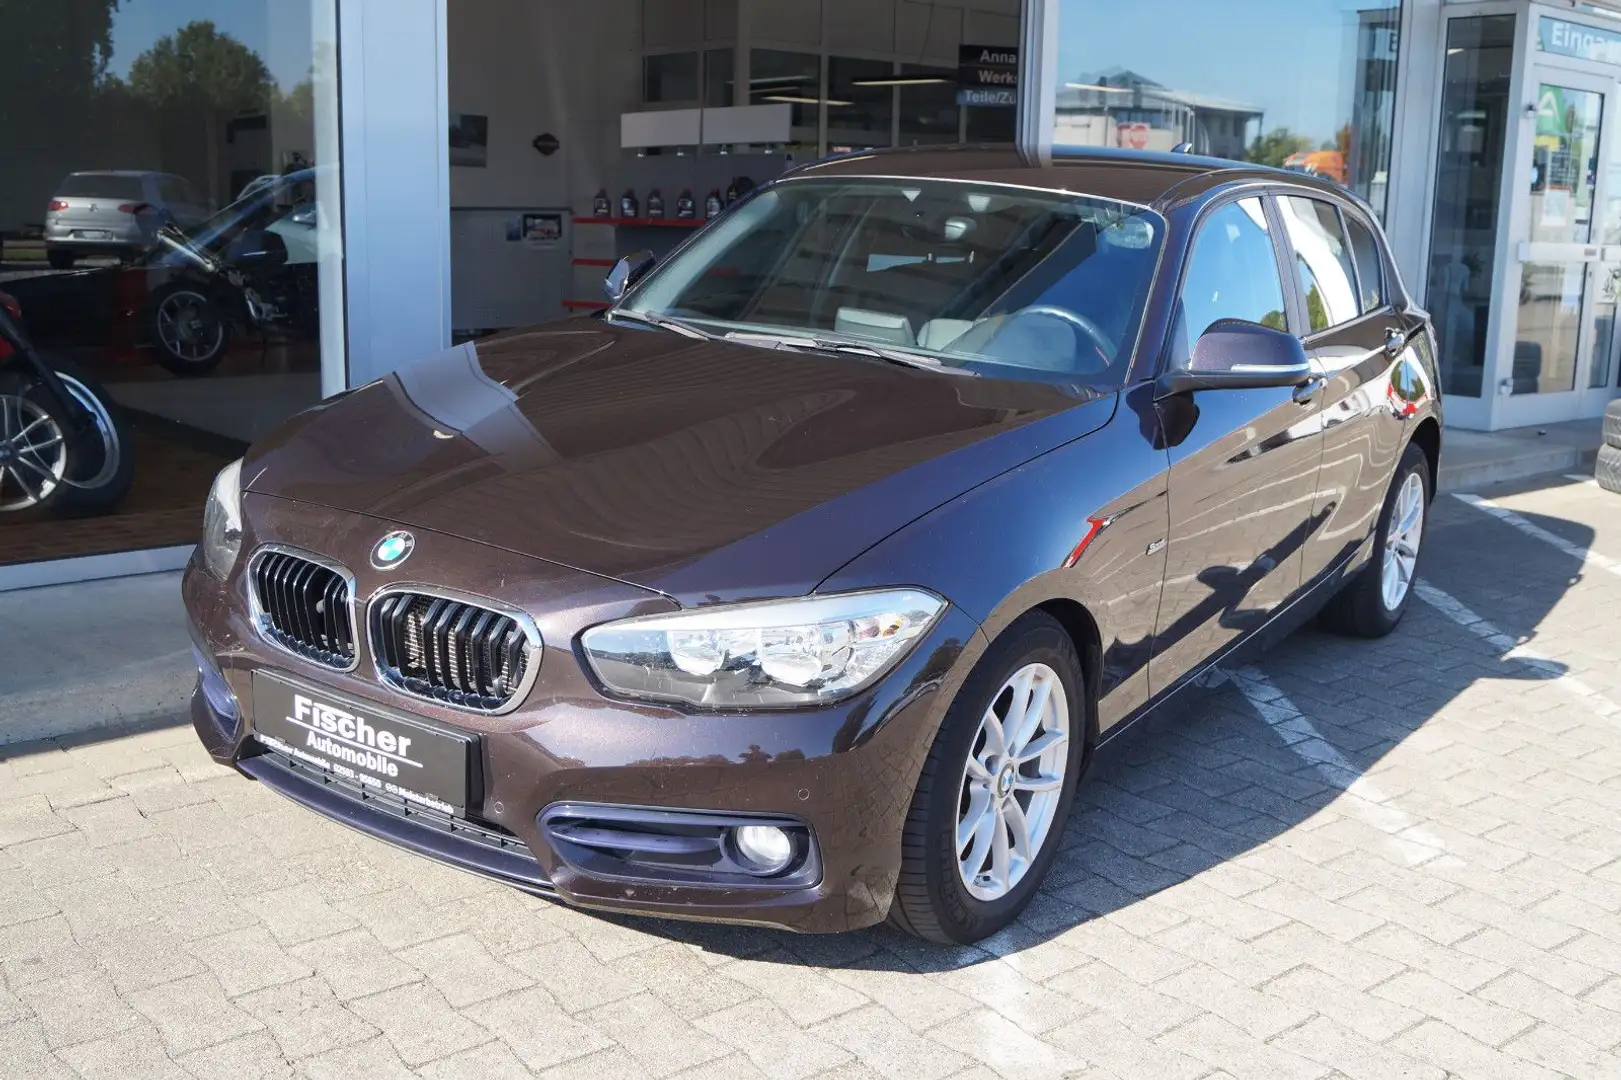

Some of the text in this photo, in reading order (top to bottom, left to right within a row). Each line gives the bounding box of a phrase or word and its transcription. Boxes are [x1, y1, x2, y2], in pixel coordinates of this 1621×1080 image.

[980, 49, 1017, 63] Anna
[964, 90, 1017, 104] Teile/Zu
[294, 694, 411, 757] Fischer
[306, 730, 399, 777] Automobile
